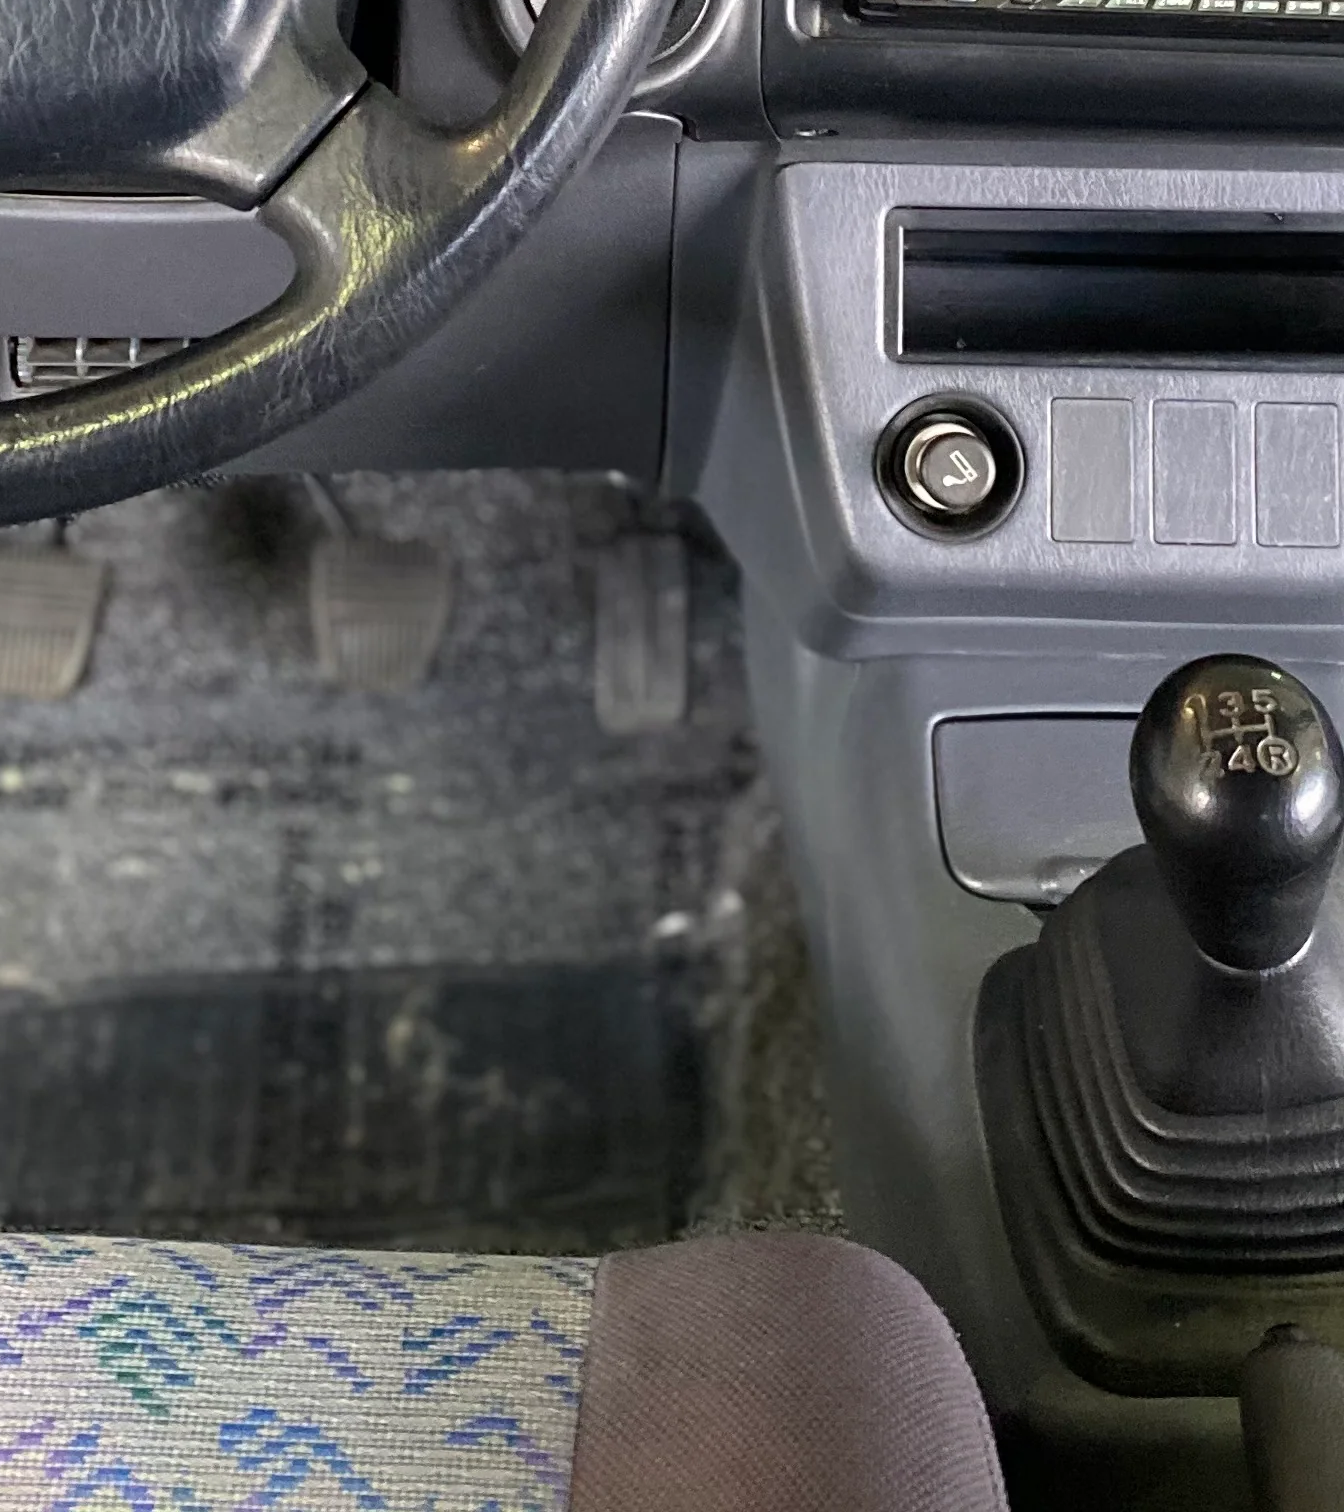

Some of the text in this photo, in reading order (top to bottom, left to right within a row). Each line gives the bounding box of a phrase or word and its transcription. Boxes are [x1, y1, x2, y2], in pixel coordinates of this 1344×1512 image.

[1217, 690, 1245, 717] 3
[1251, 688, 1279, 714] 5
[1227, 744, 1257, 774] 4
[1268, 745, 1293, 771] R
